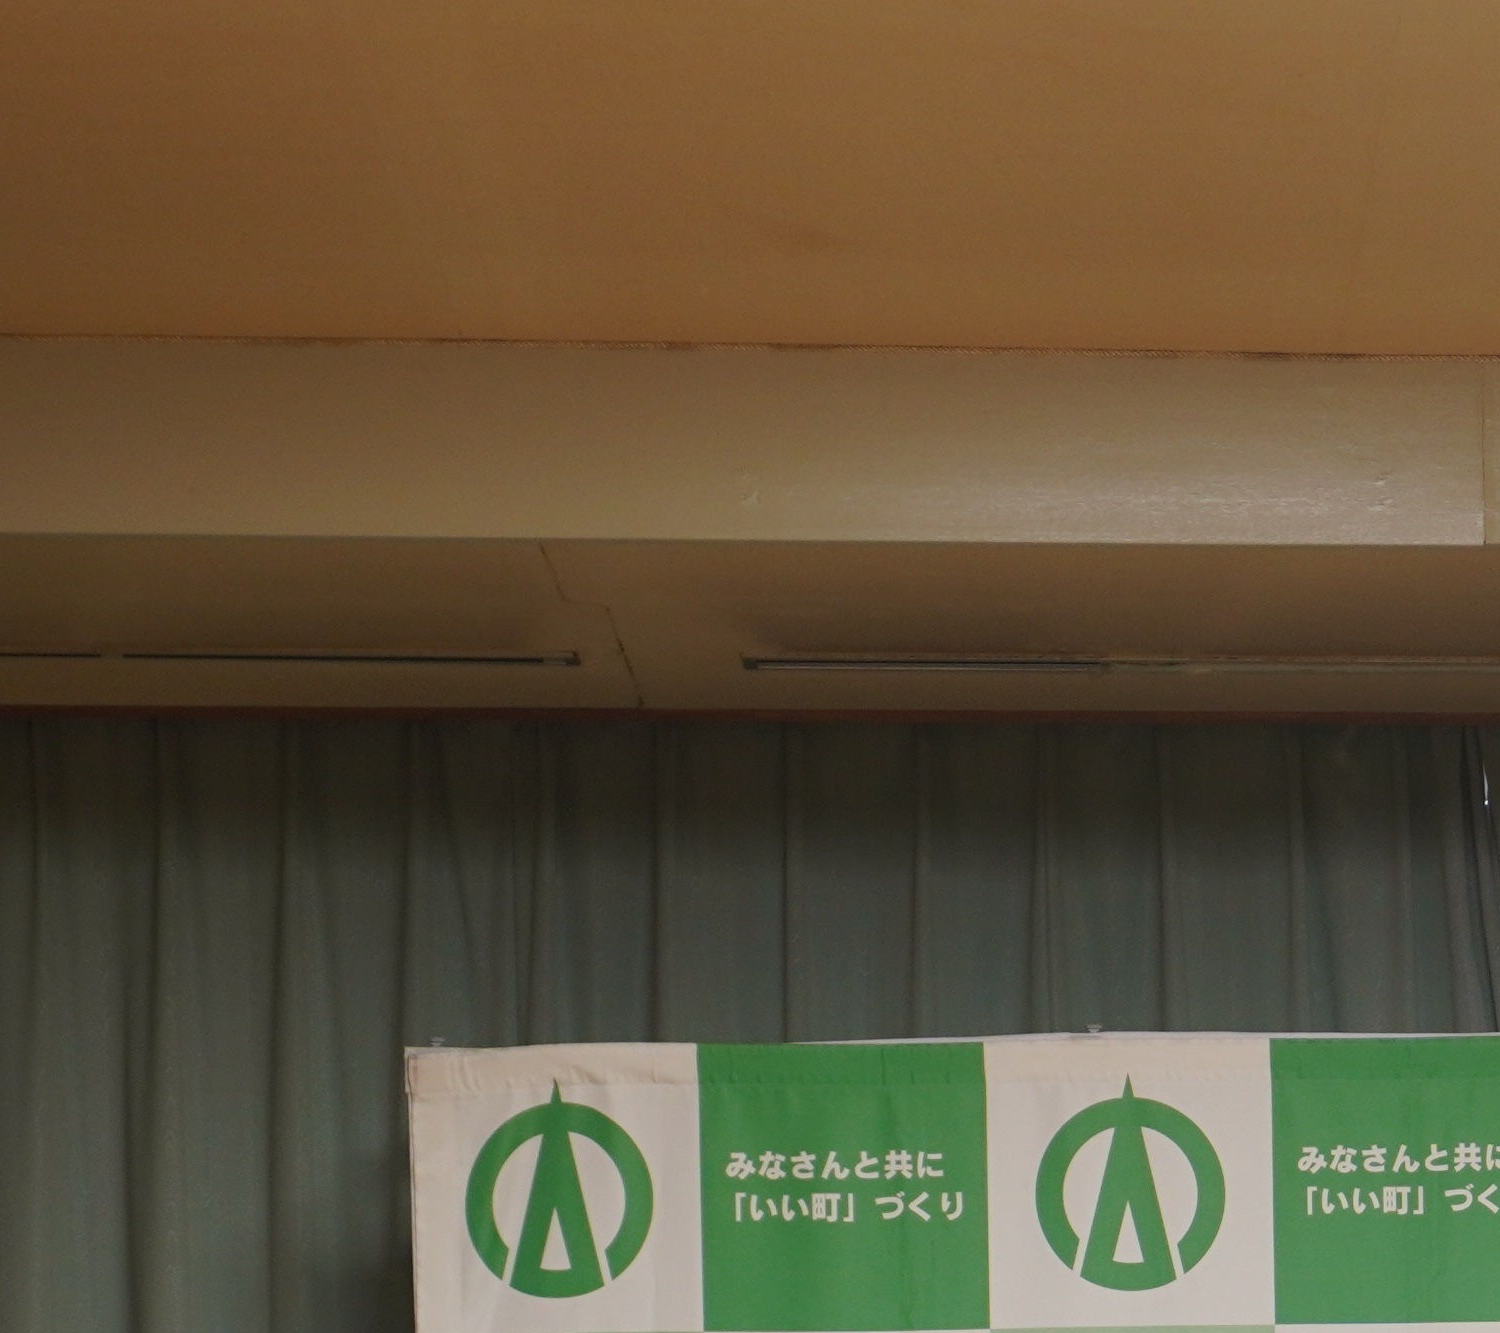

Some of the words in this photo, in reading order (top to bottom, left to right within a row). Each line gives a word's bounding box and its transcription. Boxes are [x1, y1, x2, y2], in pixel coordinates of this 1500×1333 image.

[725, 1149, 944, 1180] みなさんと共に
